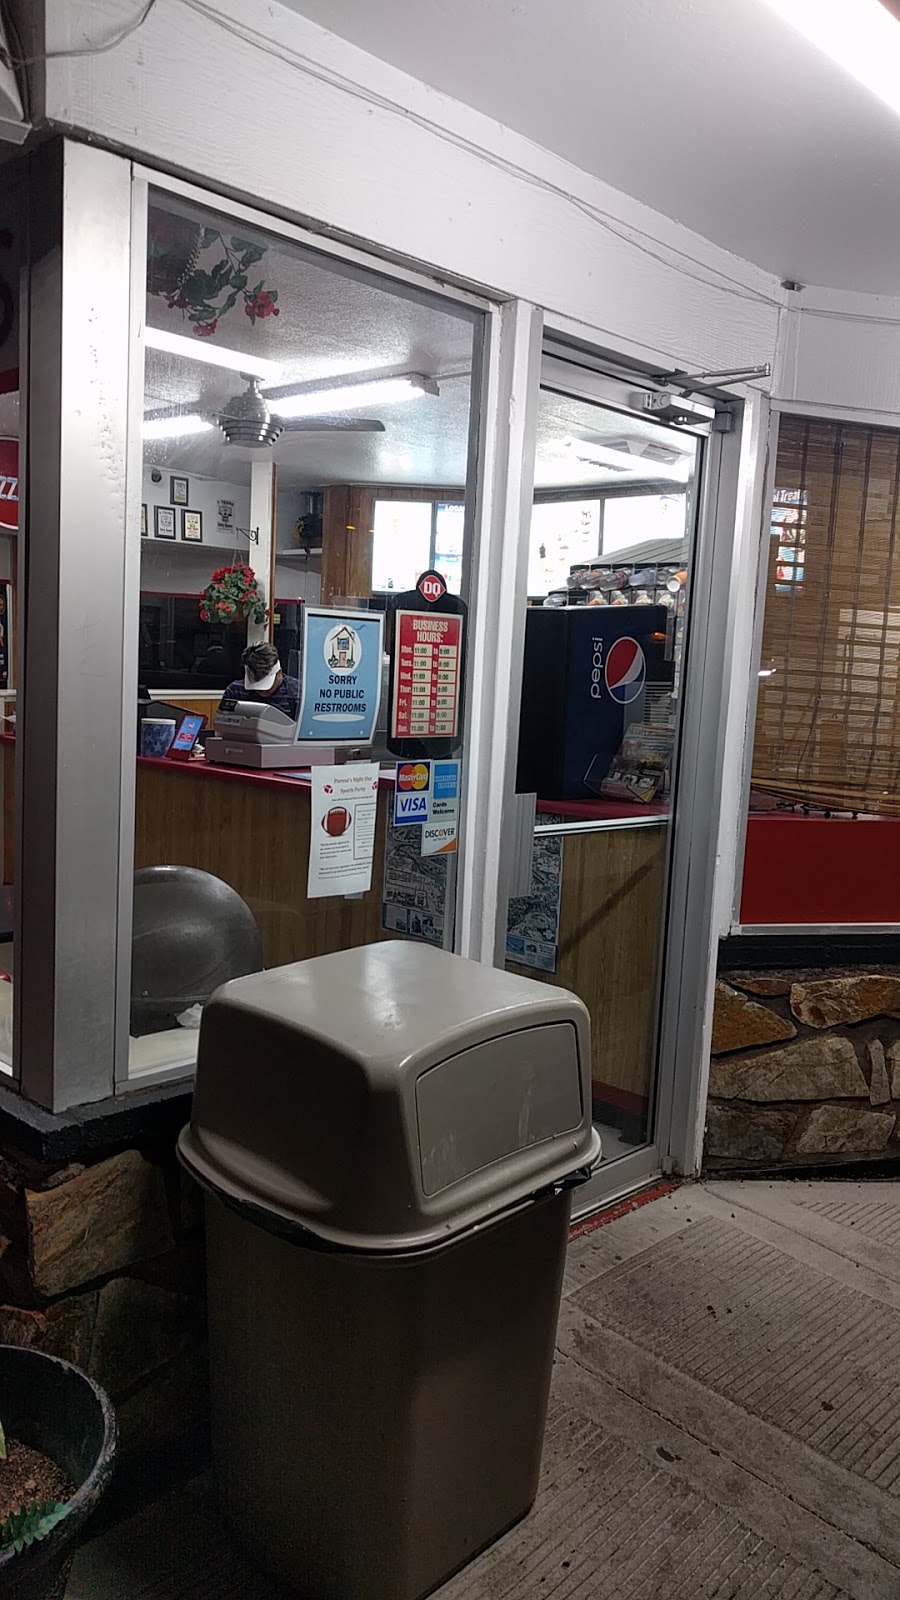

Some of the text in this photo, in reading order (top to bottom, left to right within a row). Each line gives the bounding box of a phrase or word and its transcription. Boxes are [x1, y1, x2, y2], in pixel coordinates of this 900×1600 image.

[423, 581, 441, 597] DQ
[413, 619, 448, 632] BUSINESS
[417, 631, 444, 643] HOURS:
[590, 637, 604, 699] pepsi
[328, 674, 358, 685] SORRY
[319, 688, 365, 699] NO PUBLIC
[314, 702, 367, 712] RESTROOMS
[399, 773, 428, 782] MasterCard
[400, 796, 427, 812] VISA
[425, 827, 455, 839] DISCOVER
